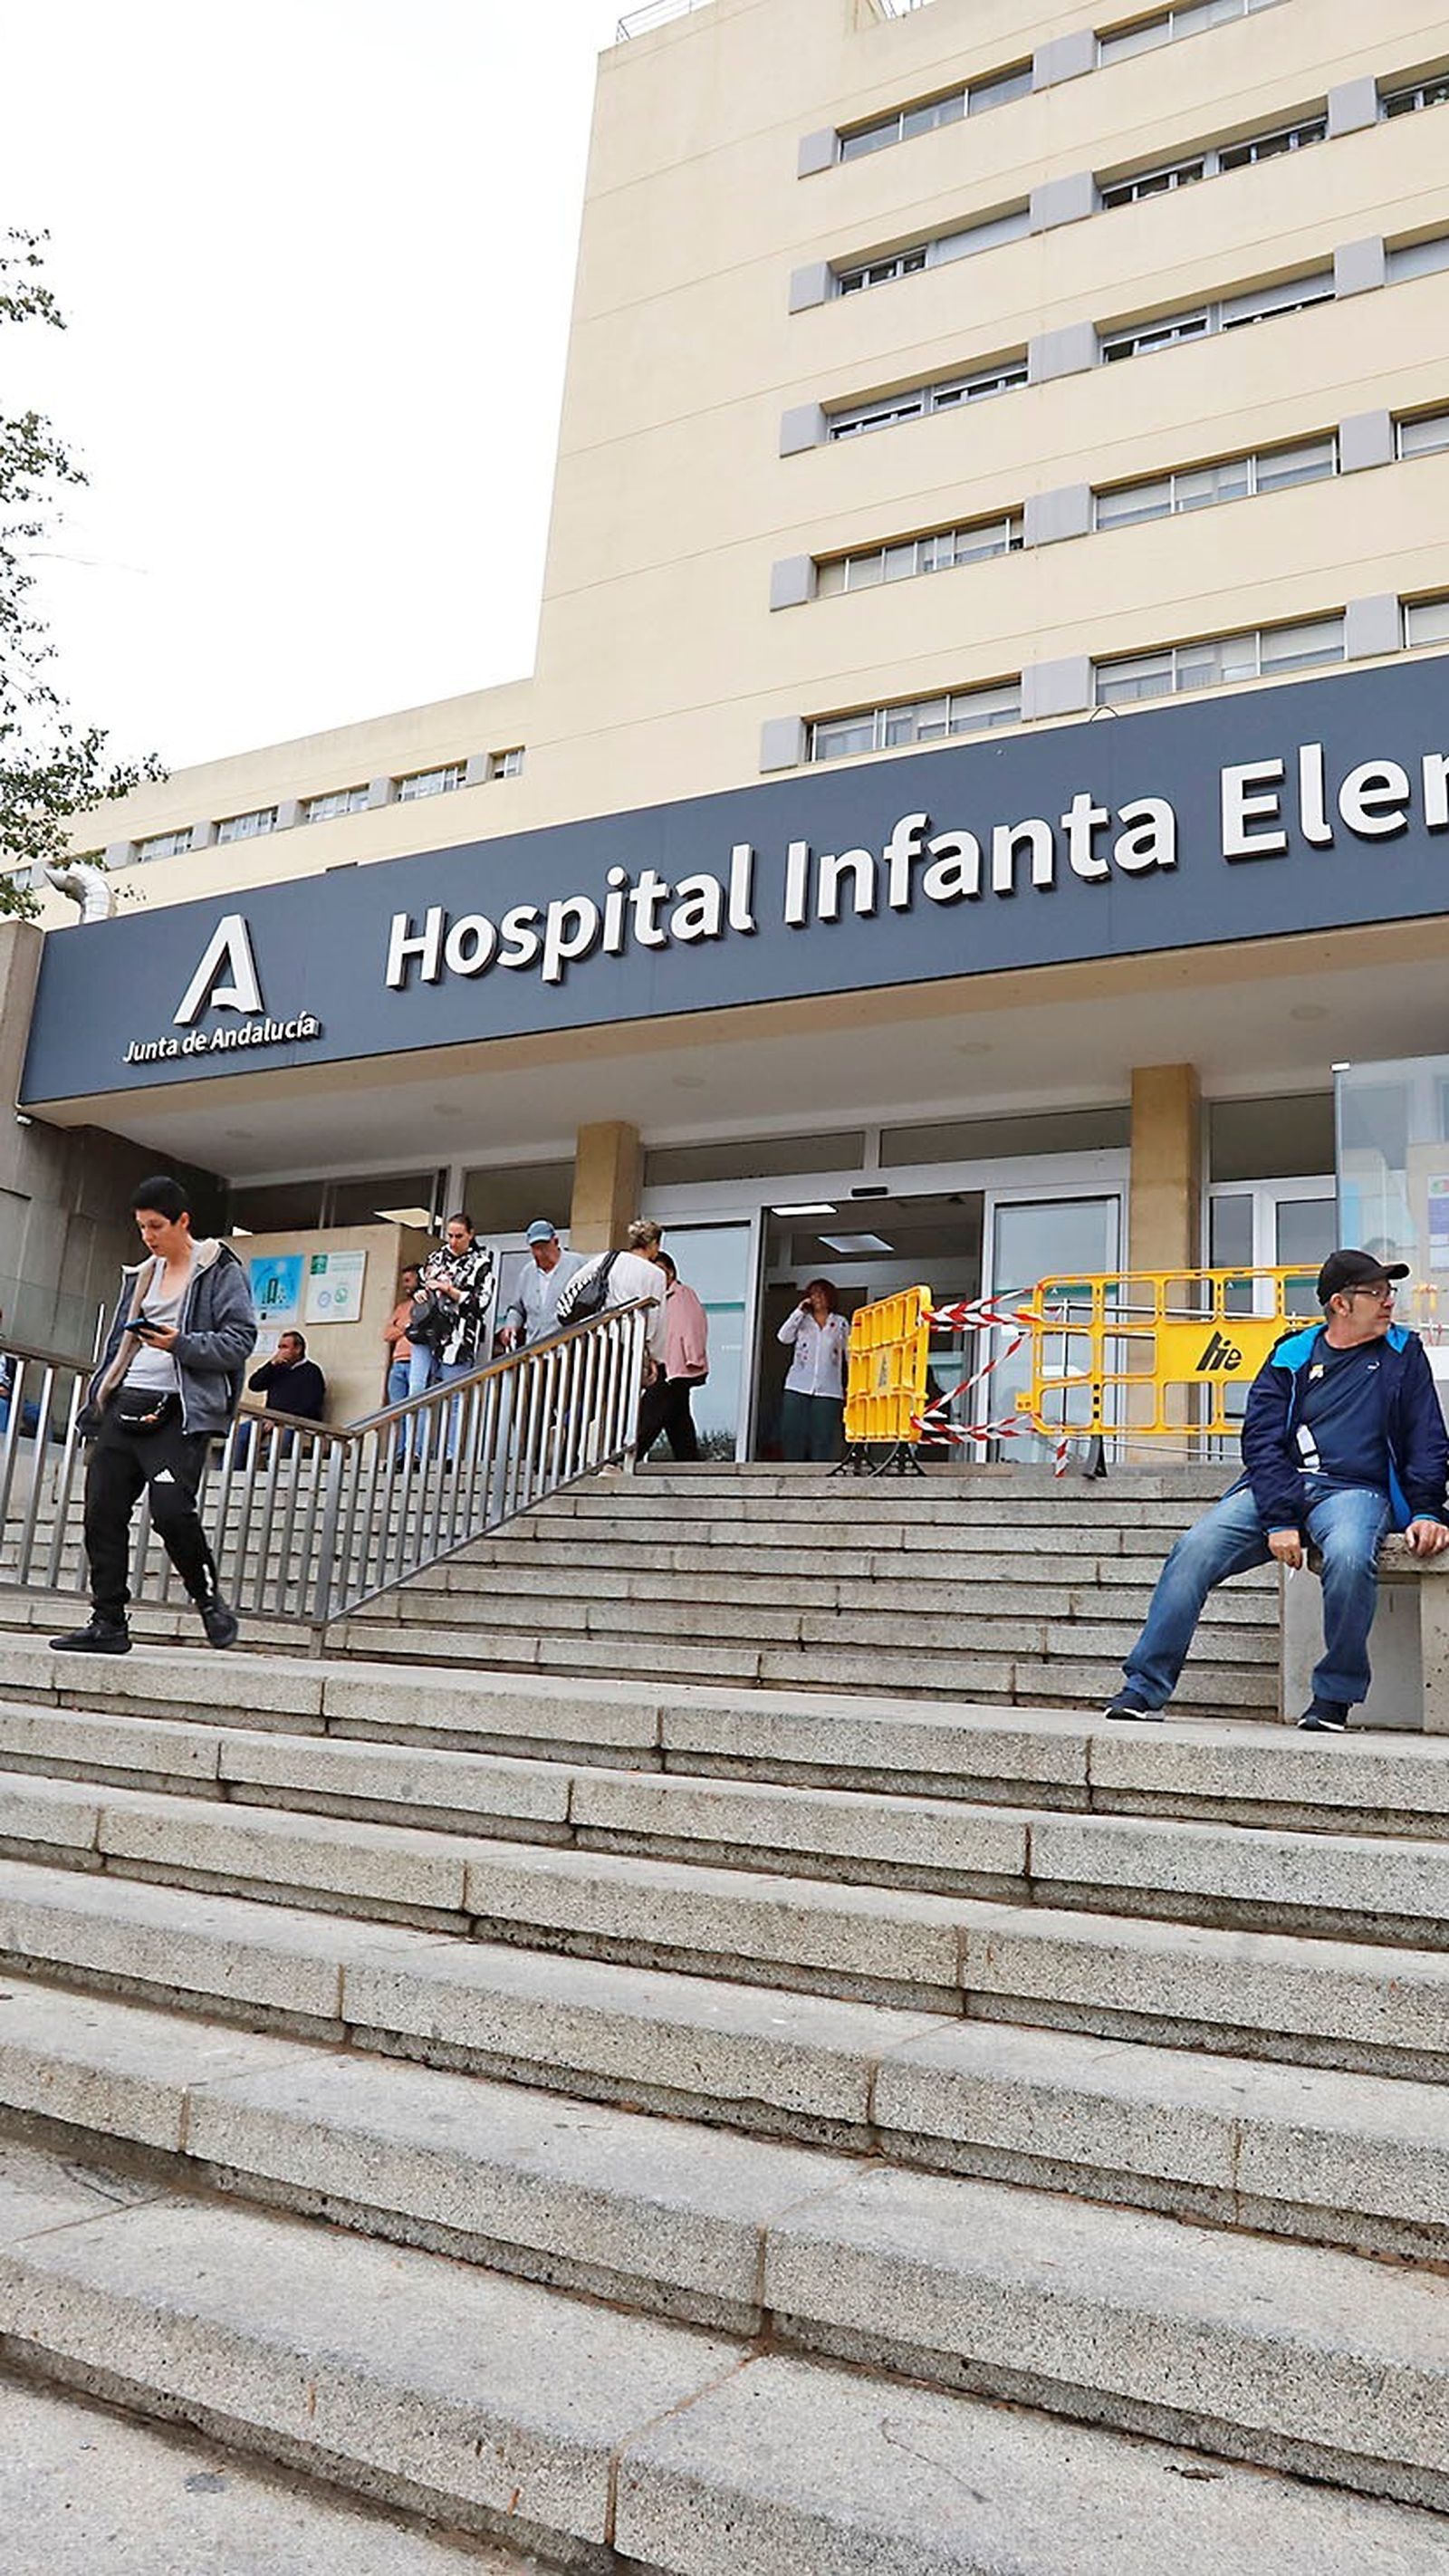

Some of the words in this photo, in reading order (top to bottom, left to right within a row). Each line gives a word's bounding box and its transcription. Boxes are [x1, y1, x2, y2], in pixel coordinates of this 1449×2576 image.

[385, 842, 755, 991] Hospital
[784, 793, 1177, 927] Infanta
[123, 1040, 179, 1063] Junta
[181, 1030, 207, 1054] de
[210, 1011, 319, 1050] Andalucía
